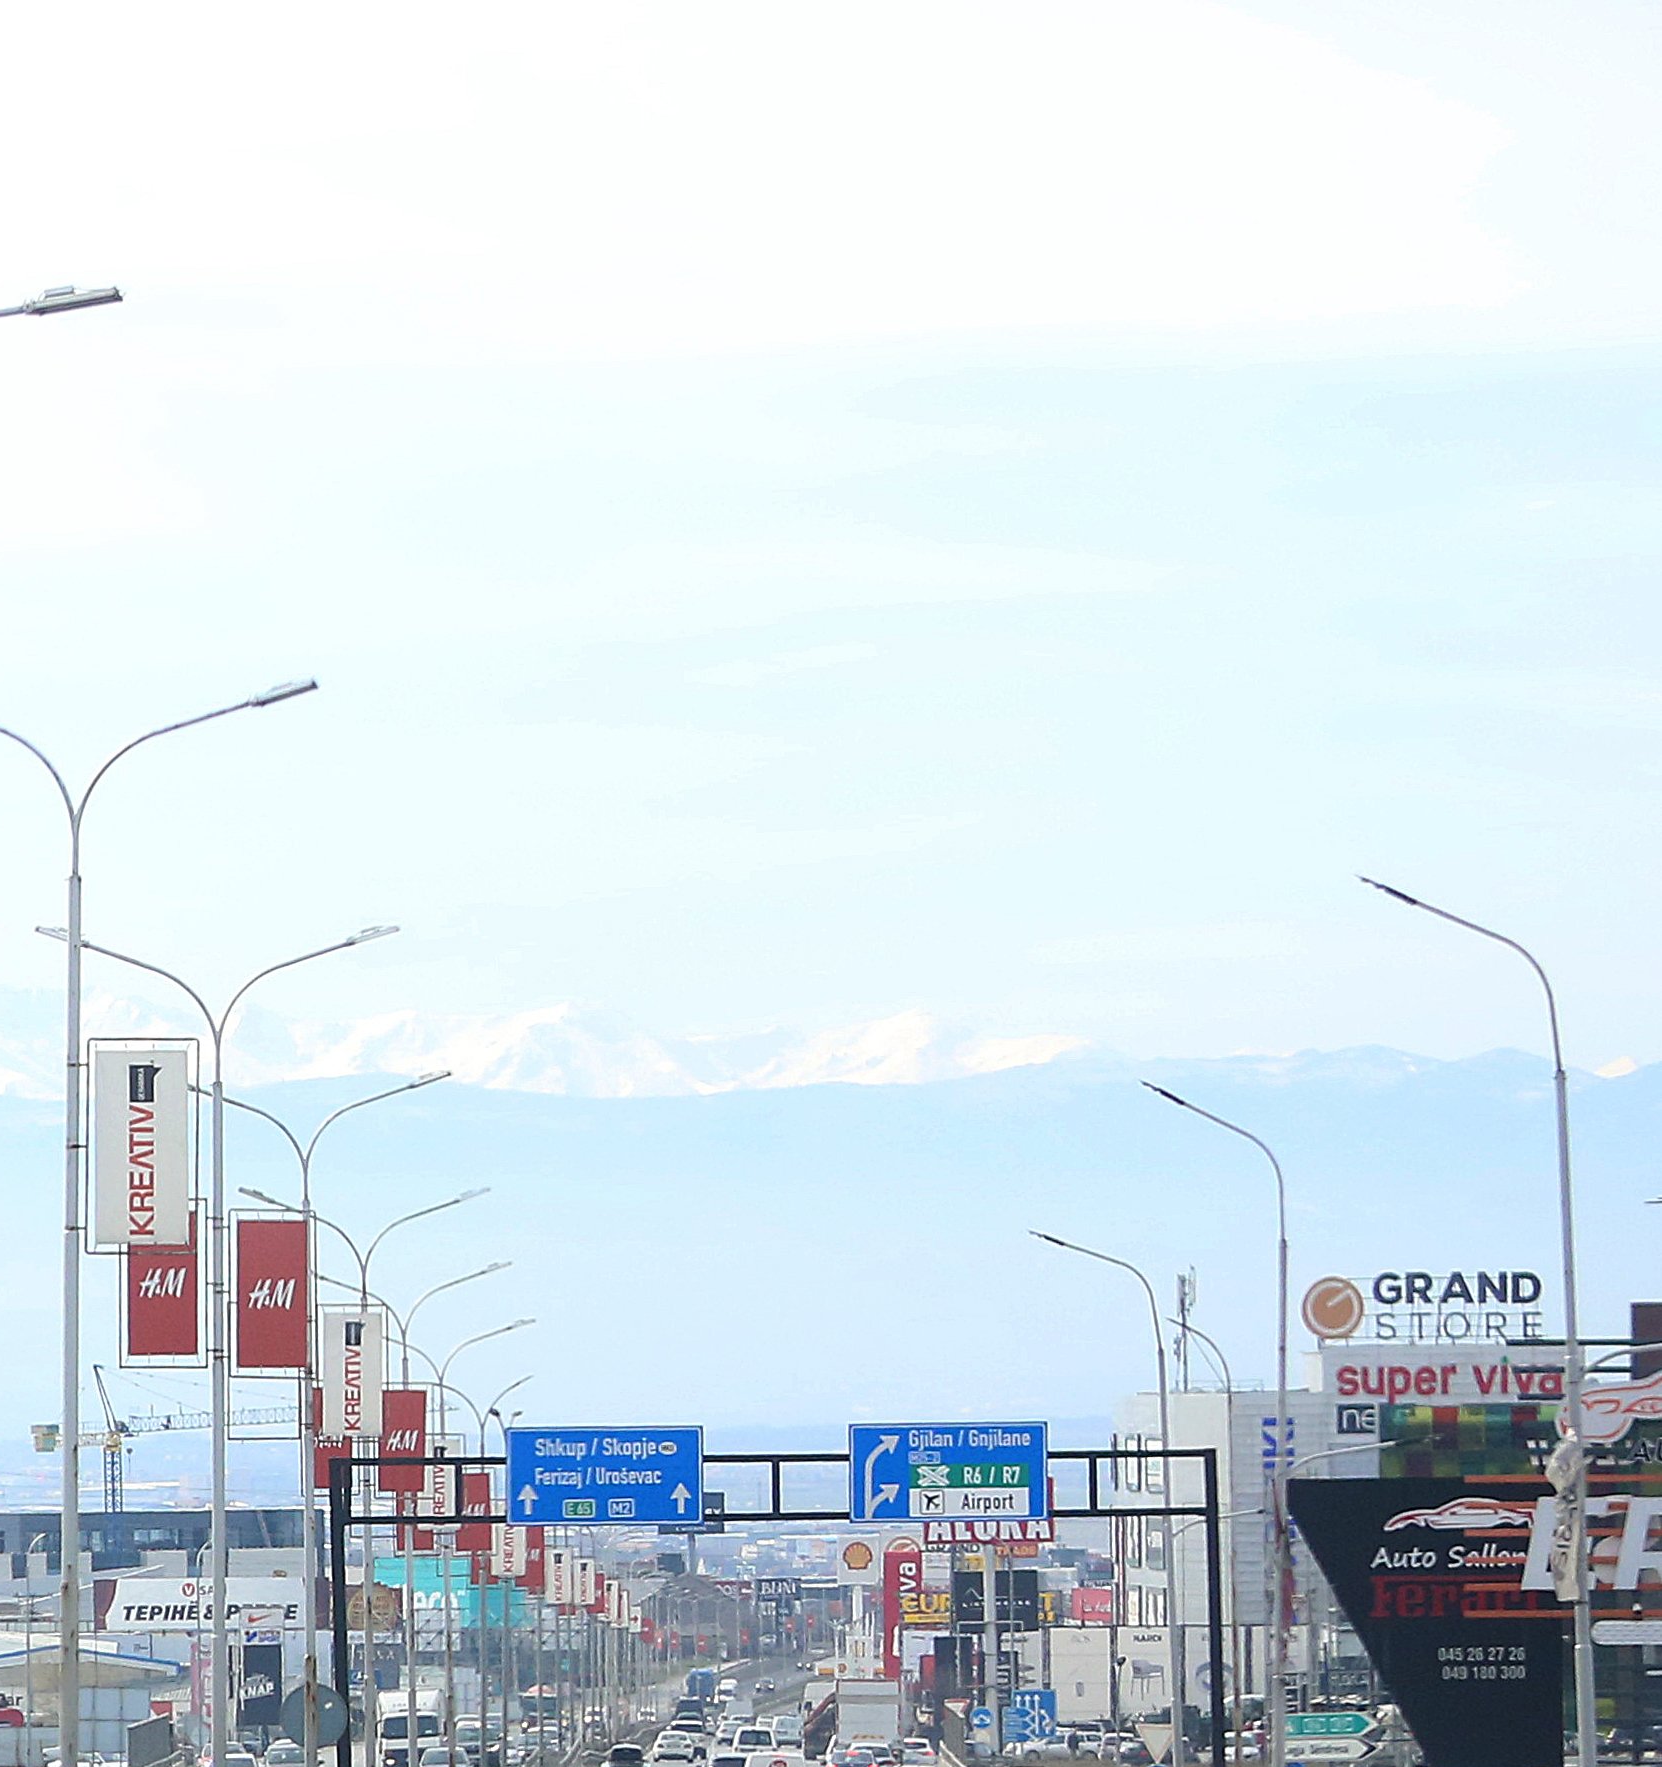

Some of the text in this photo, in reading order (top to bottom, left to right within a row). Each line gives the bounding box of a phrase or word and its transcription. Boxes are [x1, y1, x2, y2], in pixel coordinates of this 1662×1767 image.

[129, 1105, 155, 1236] KREATIV
[139, 1266, 187, 1299] H&M
[248, 1277, 297, 1310] H&M
[1373, 1271, 1542, 1305] GRAND
[1375, 1311, 1543, 1340] STORE
[344, 1347, 361, 1431] KREATIV
[1336, 1355, 1563, 1404] super viva
[535, 1438, 587, 1461] Shkup
[602, 1438, 657, 1461] Skopje
[908, 1429, 954, 1450] Gjilan
[968, 1429, 1031, 1451] Gnjilane
[535, 1467, 582, 1489] Ferizaj
[595, 1467, 662, 1485] Uroševac
[963, 1466, 982, 1484] R6
[1002, 1466, 1021, 1484] R7
[433, 1464, 446, 1516] REATIV
[611, 1502, 631, 1515] M2
[961, 1493, 1014, 1513] Airport
[1370, 1547, 1436, 1569] Auto
[123, 1600, 197, 1622] TEPIHË
[1438, 1646, 1463, 1661] 045
